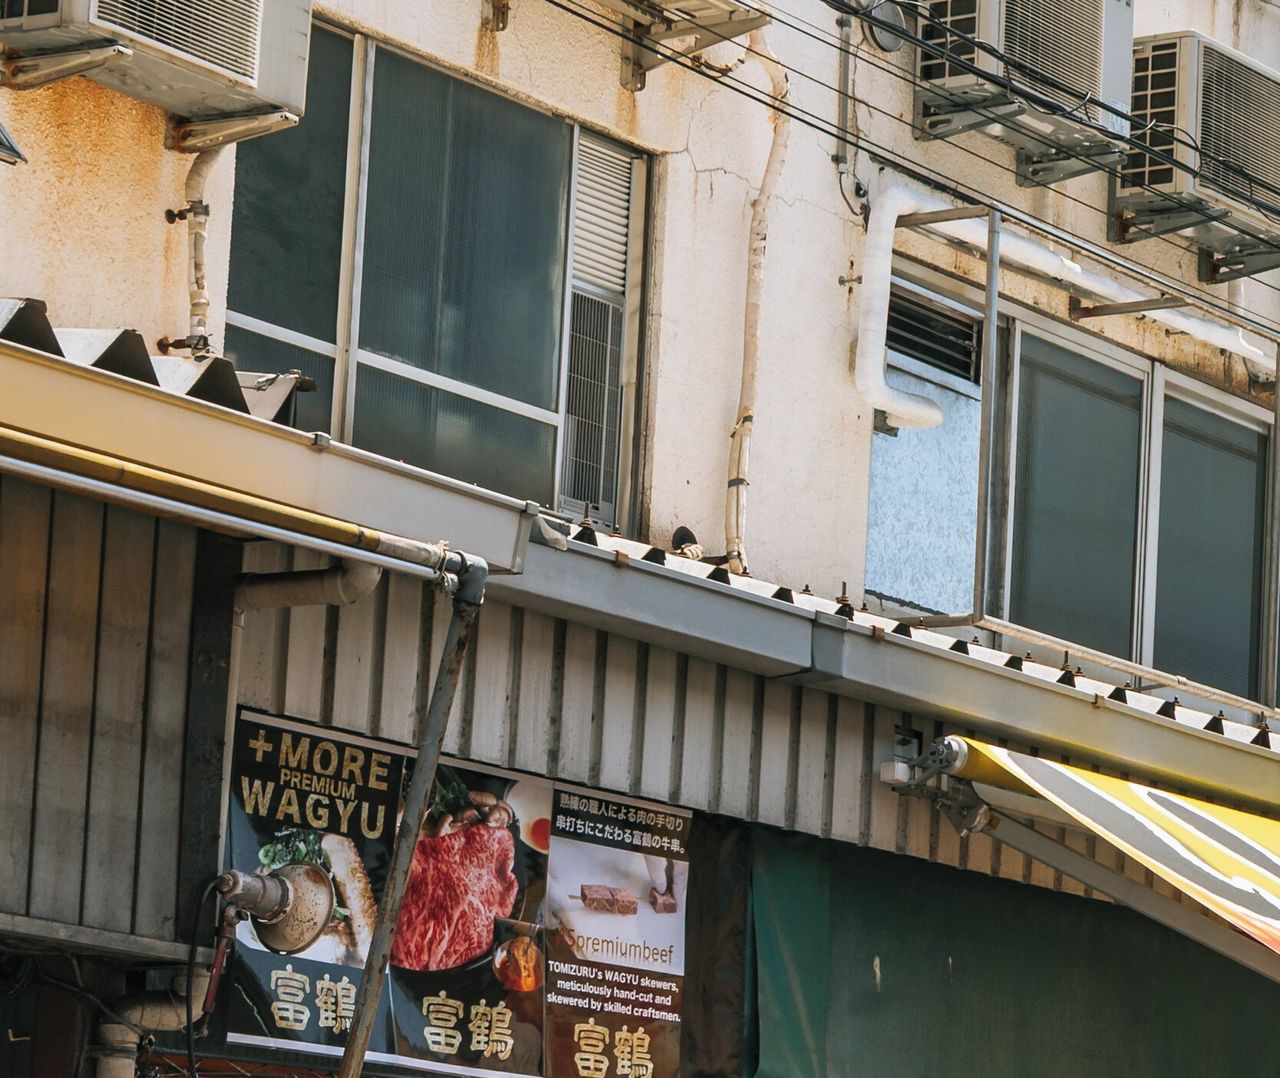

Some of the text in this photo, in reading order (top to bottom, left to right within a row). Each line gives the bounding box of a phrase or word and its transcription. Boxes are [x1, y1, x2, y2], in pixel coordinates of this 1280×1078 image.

[280, 769, 355, 800] PREMIUM
[241, 776, 386, 839] WAGYU
[548, 960, 679, 993] TOMIZURU's WAGYU skewers,
[547, 992, 680, 1022] skewered by skilled craftsmen.
[557, 980, 672, 1006] meticulously hand-cut and
[422, 990, 514, 1060] 富鶴
